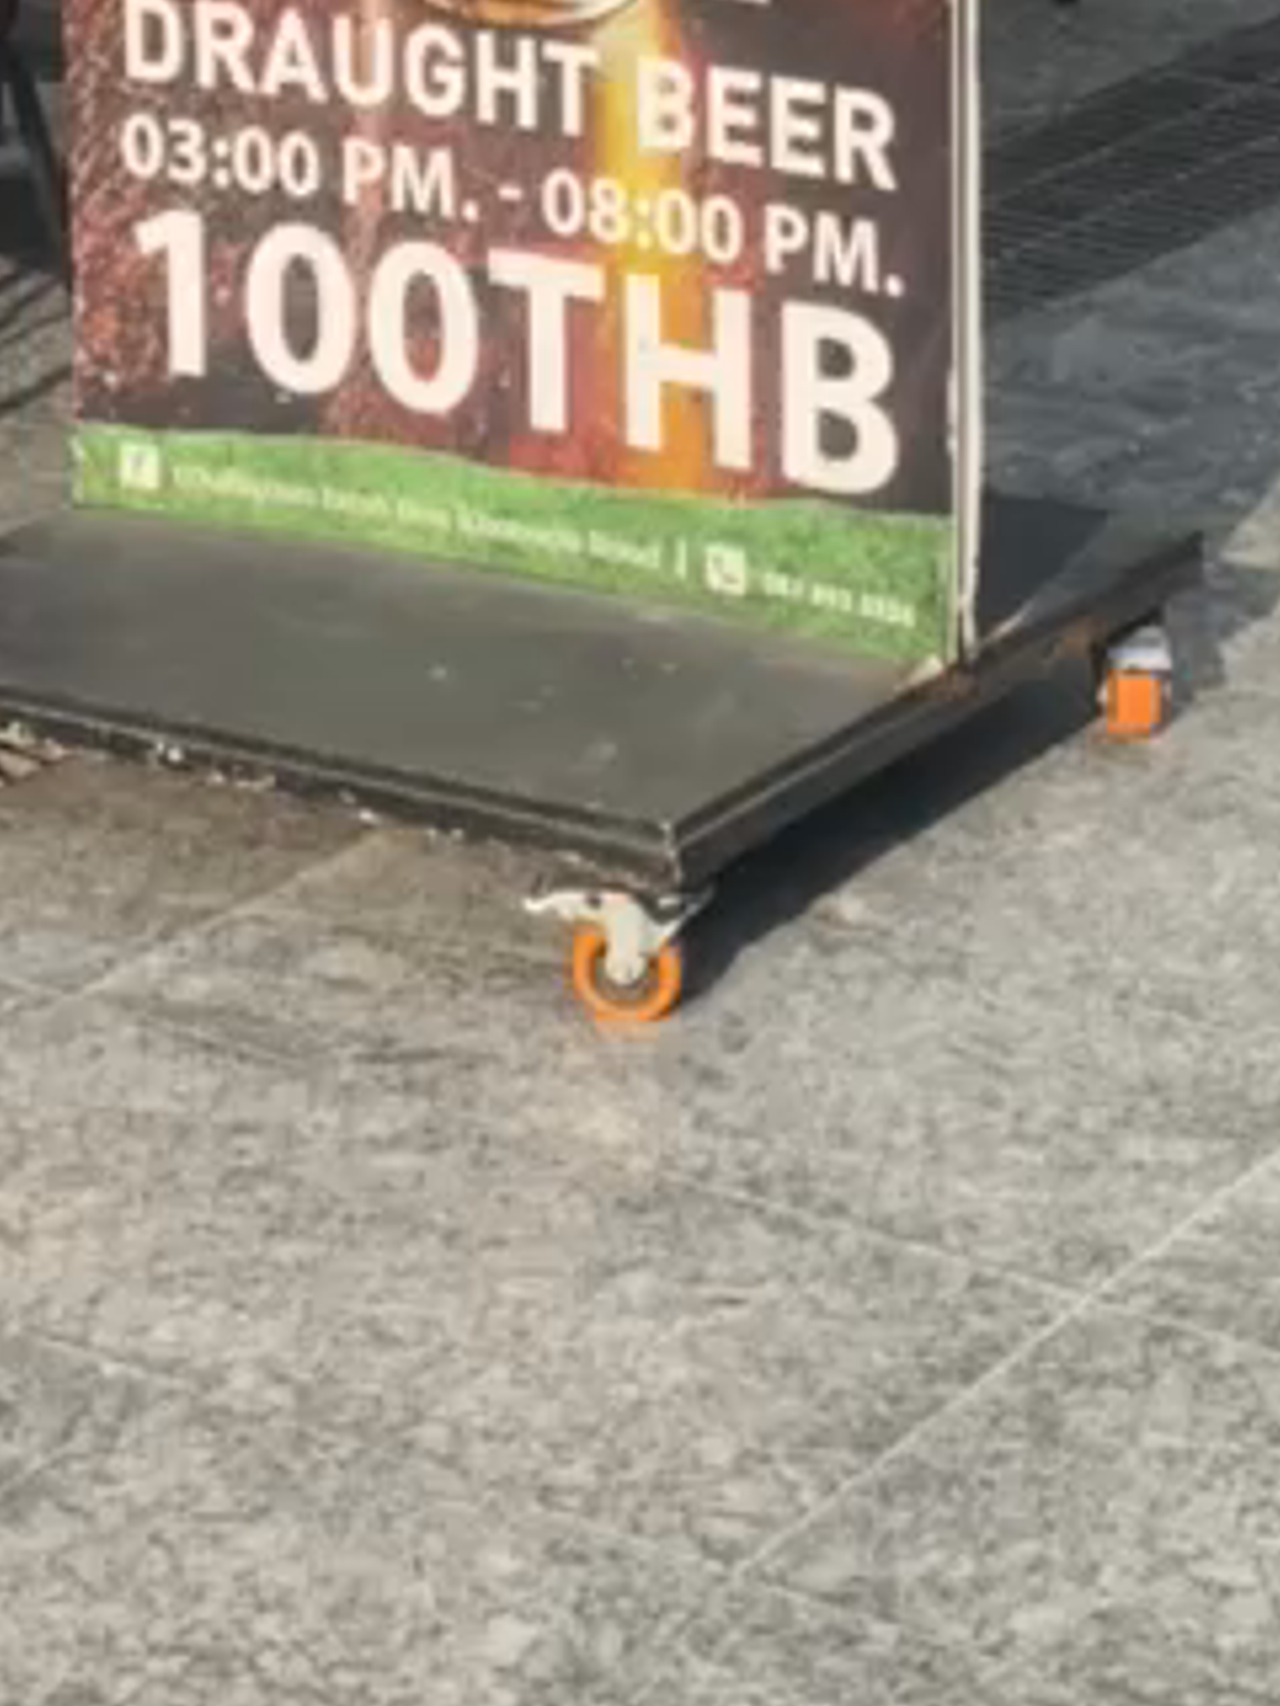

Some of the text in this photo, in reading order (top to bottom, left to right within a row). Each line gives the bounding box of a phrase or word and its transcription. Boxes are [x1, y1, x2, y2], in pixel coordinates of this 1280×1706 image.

[119, 112, 321, 198] 03:00
[341, 133, 482, 224] PM.
[541, 166, 744, 266] 08:00
[762, 203, 905, 298] PM.
[636, 54, 898, 192] BEER
[134, 207, 900, 497] 100THB
